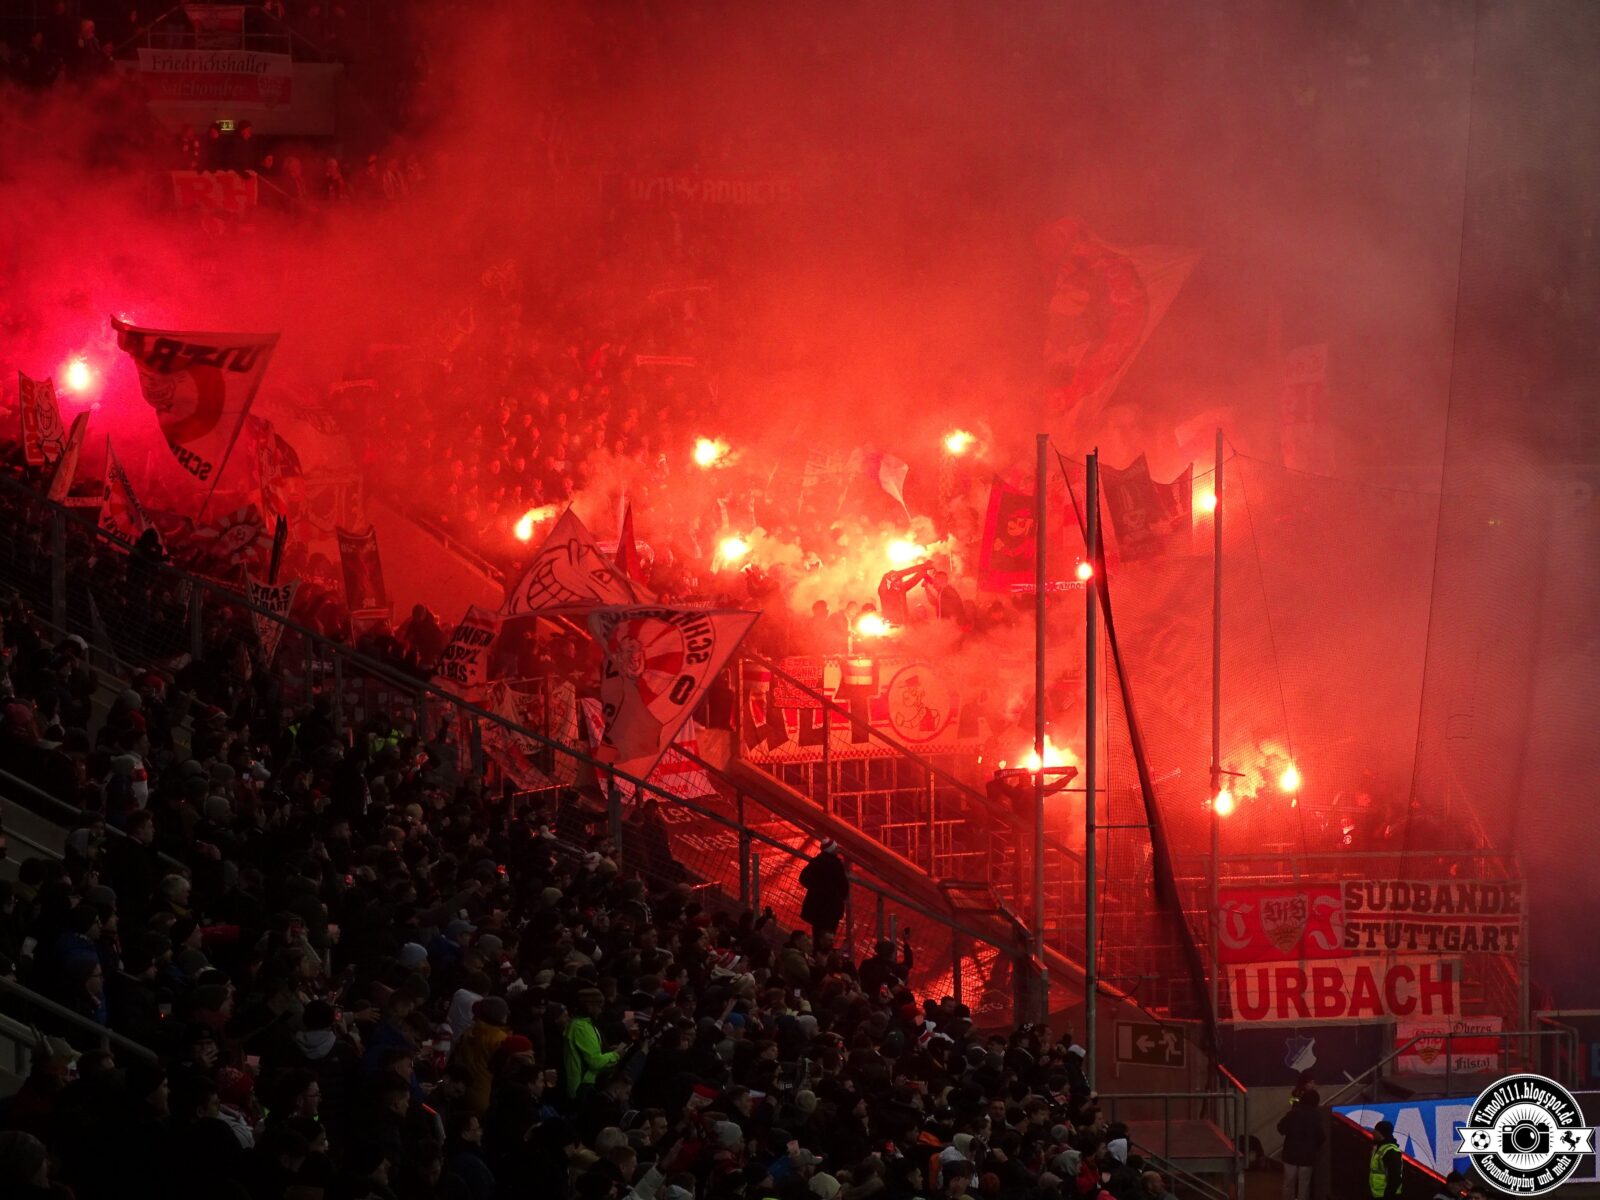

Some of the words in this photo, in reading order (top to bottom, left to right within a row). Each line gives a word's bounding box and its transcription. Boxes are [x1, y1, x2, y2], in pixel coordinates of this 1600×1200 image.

[152, 55, 269, 73] Friedrichshaller
[1344, 922, 1520, 950] STUTTGART
[1235, 964, 1454, 1020] URBACH
